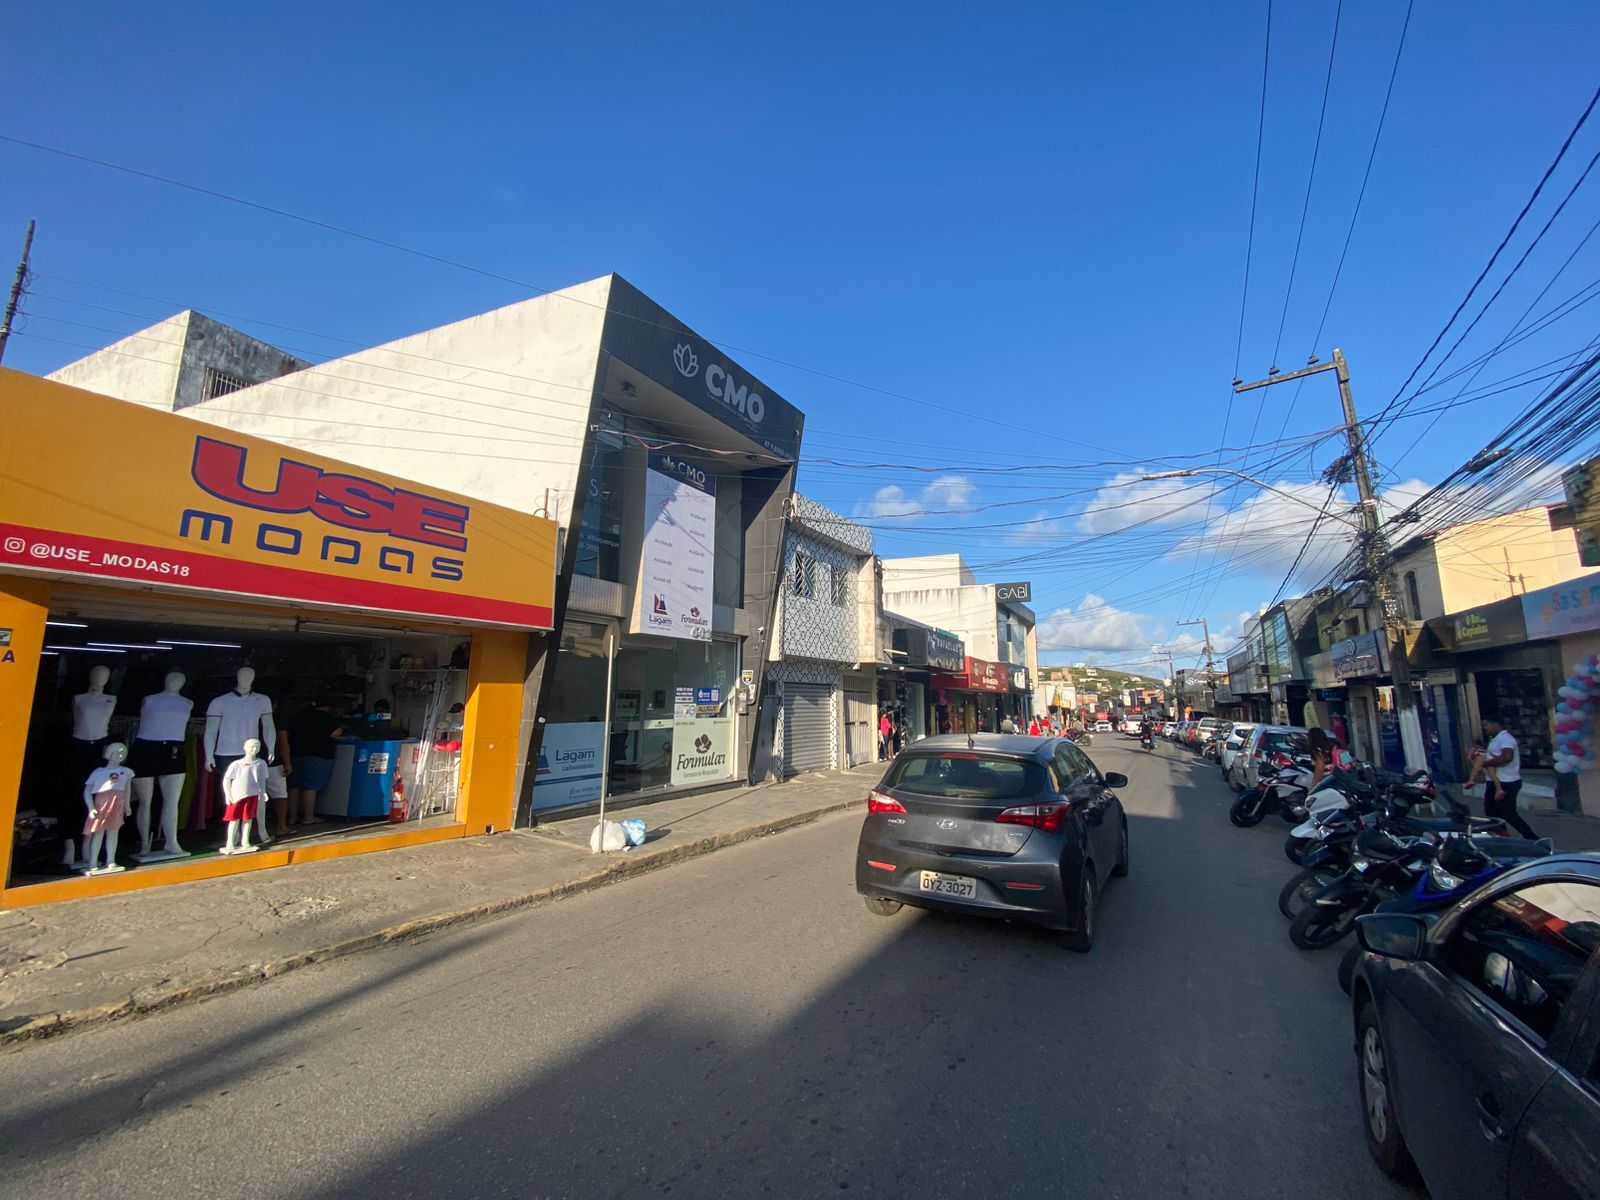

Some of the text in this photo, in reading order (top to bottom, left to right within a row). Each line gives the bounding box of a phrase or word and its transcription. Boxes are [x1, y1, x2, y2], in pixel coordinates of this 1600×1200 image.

[705, 363, 765, 423] CMO
[677, 461, 706, 484] CMO
[191, 435, 470, 552] USE
[30, 543, 190, 577] @USE_MODAS18
[649, 614, 672, 625] Lagam
[555, 750, 595, 763] Lagam
[676, 752, 726, 771] Formular
